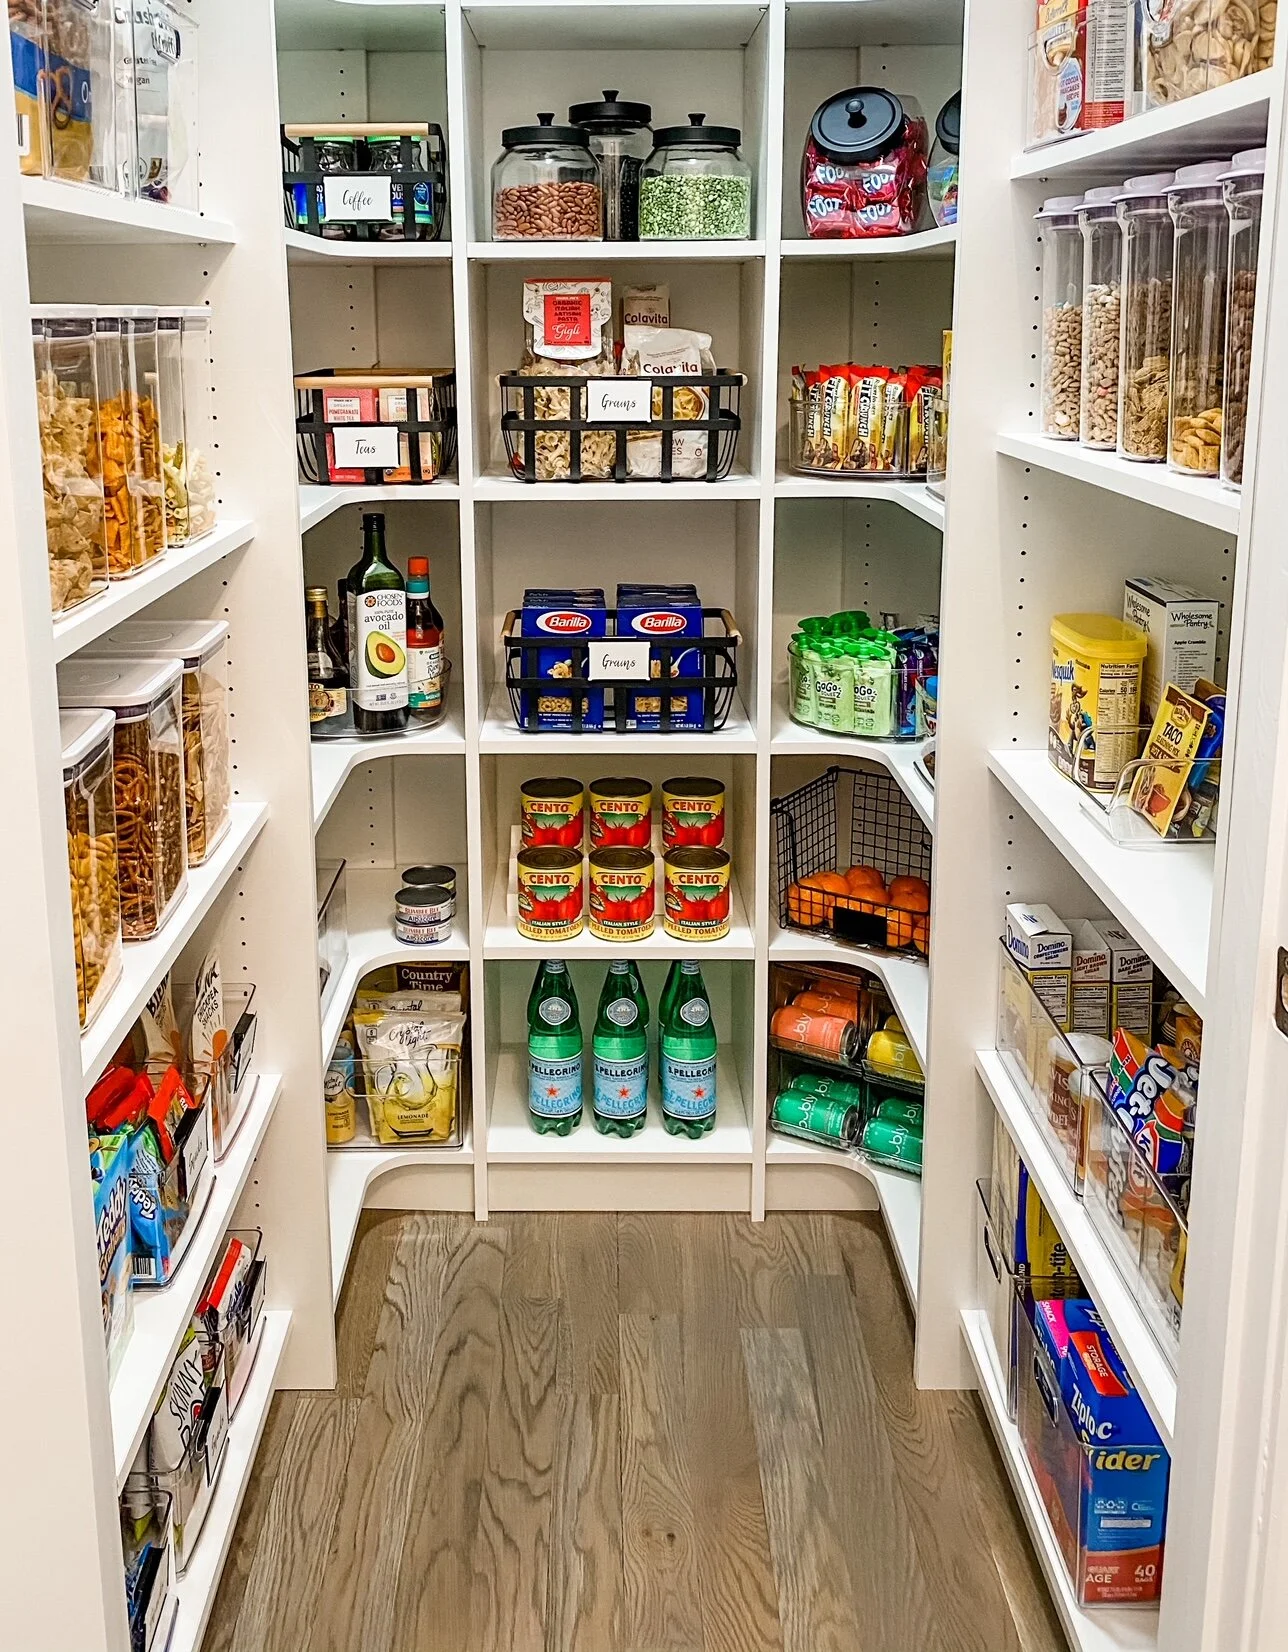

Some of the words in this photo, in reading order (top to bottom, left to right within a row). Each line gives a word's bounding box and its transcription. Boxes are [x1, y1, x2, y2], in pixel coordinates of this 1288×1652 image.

[342, 189, 373, 212] Coffee
[624, 313, 669, 324] Colavita
[552, 323, 580, 340] Gigli
[601, 394, 636, 411] Grains
[364, 611, 404, 623] avocado
[549, 616, 587, 628] Barilla
[644, 616, 682, 628] Barilla
[1171, 612, 1213, 621] Wholesome
[378, 621, 390, 630] oil
[1184, 619, 1208, 629] Pantry
[602, 653, 636, 670] Grains
[854, 686, 873, 696] oGo
[1163, 722, 1183, 745] TACO
[530, 802, 569, 813] CENTO
[600, 802, 639, 812] CENTO
[673, 801, 713, 812] CENTO
[528, 874, 570, 885] CENTO
[601, 874, 642, 885] CENTO
[678, 874, 719, 885] CENTO
[1037, 940, 1066, 953] Domino
[1045, 953, 1059, 961] SUGAR
[1076, 952, 1106, 966] Domino
[1119, 952, 1150, 967] Domino
[401, 968, 453, 983] Country
[409, 981, 444, 991] Time
[1042, 1301, 1057, 1323] SNACK
[1086, 1344, 1109, 1378] STORAGE
[1134, 1564, 1156, 1577] 40
